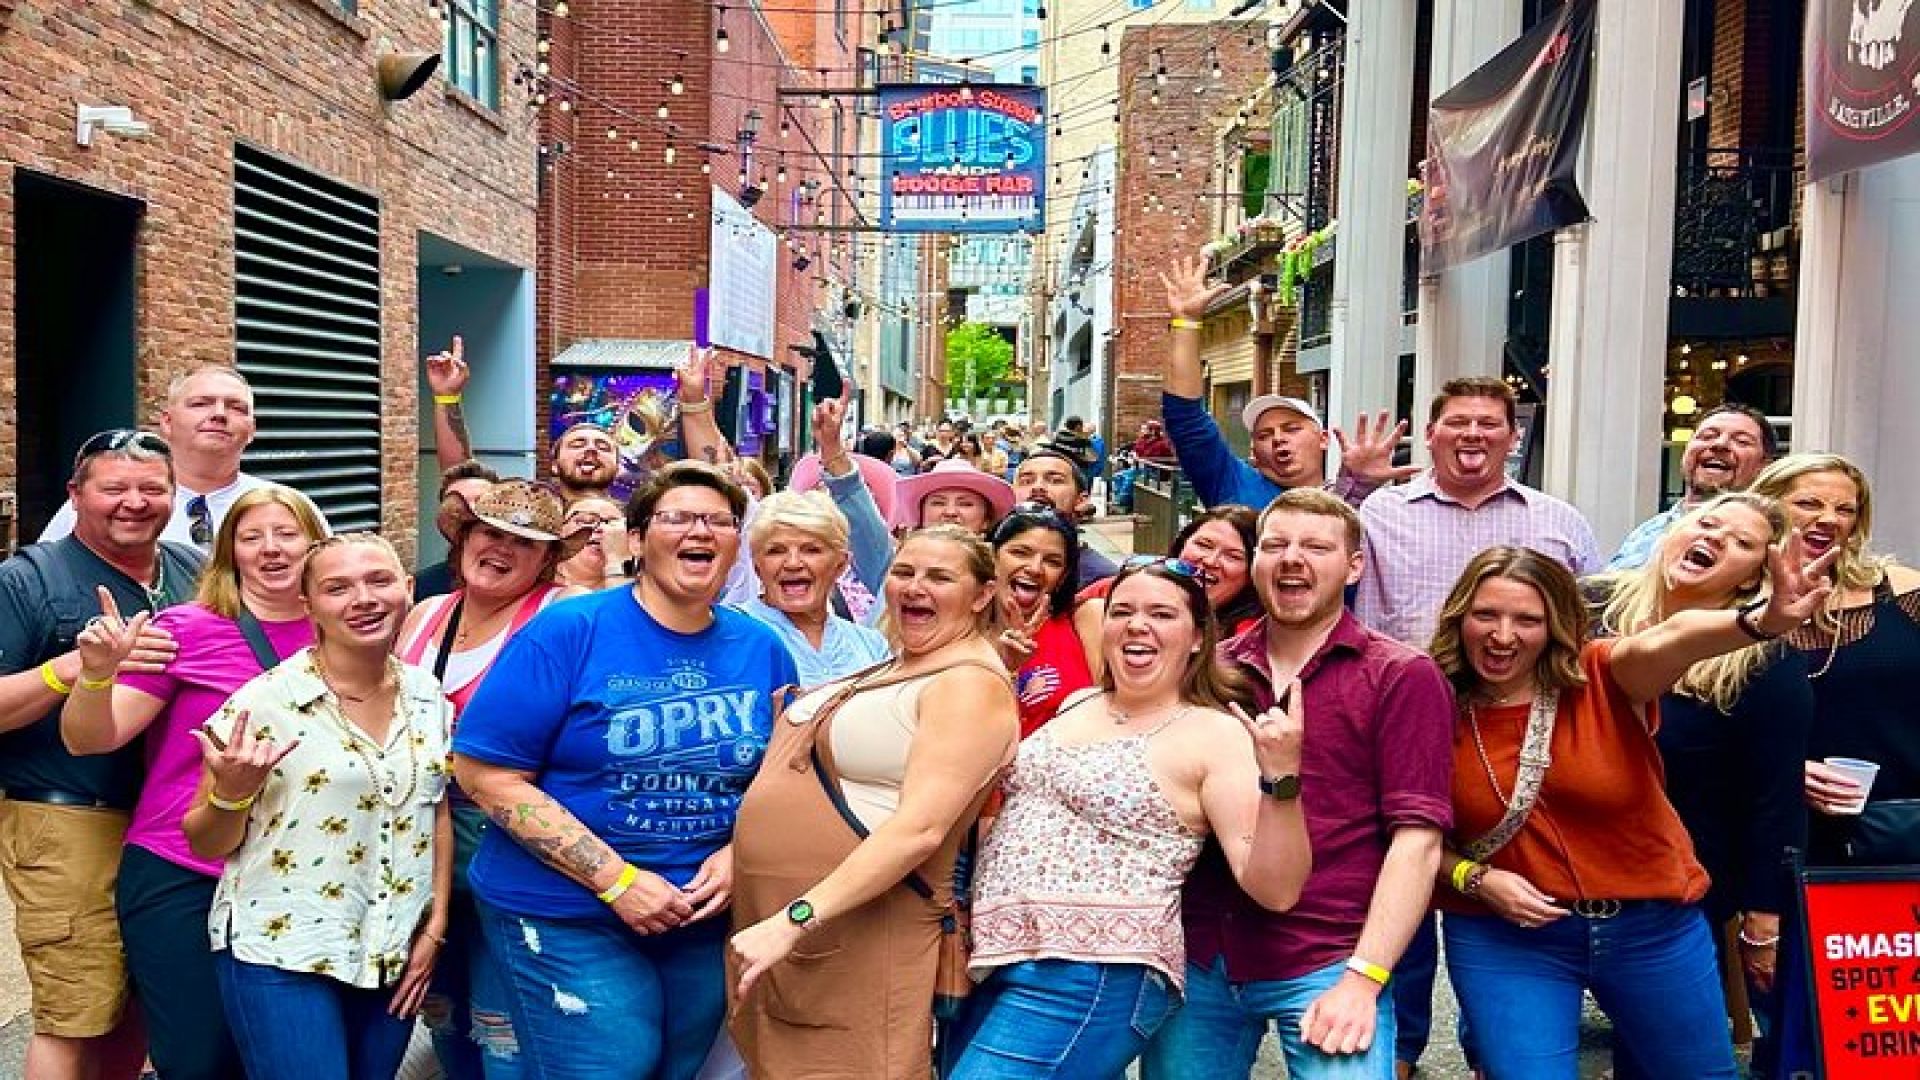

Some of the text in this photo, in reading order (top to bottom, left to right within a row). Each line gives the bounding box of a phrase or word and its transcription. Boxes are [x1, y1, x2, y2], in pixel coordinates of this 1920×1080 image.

[893, 109, 1033, 163] BLUES
[893, 176, 1033, 192] BOOGIE BAR
[606, 690, 759, 756] OPRY
[1832, 966, 1899, 990] SPOT
